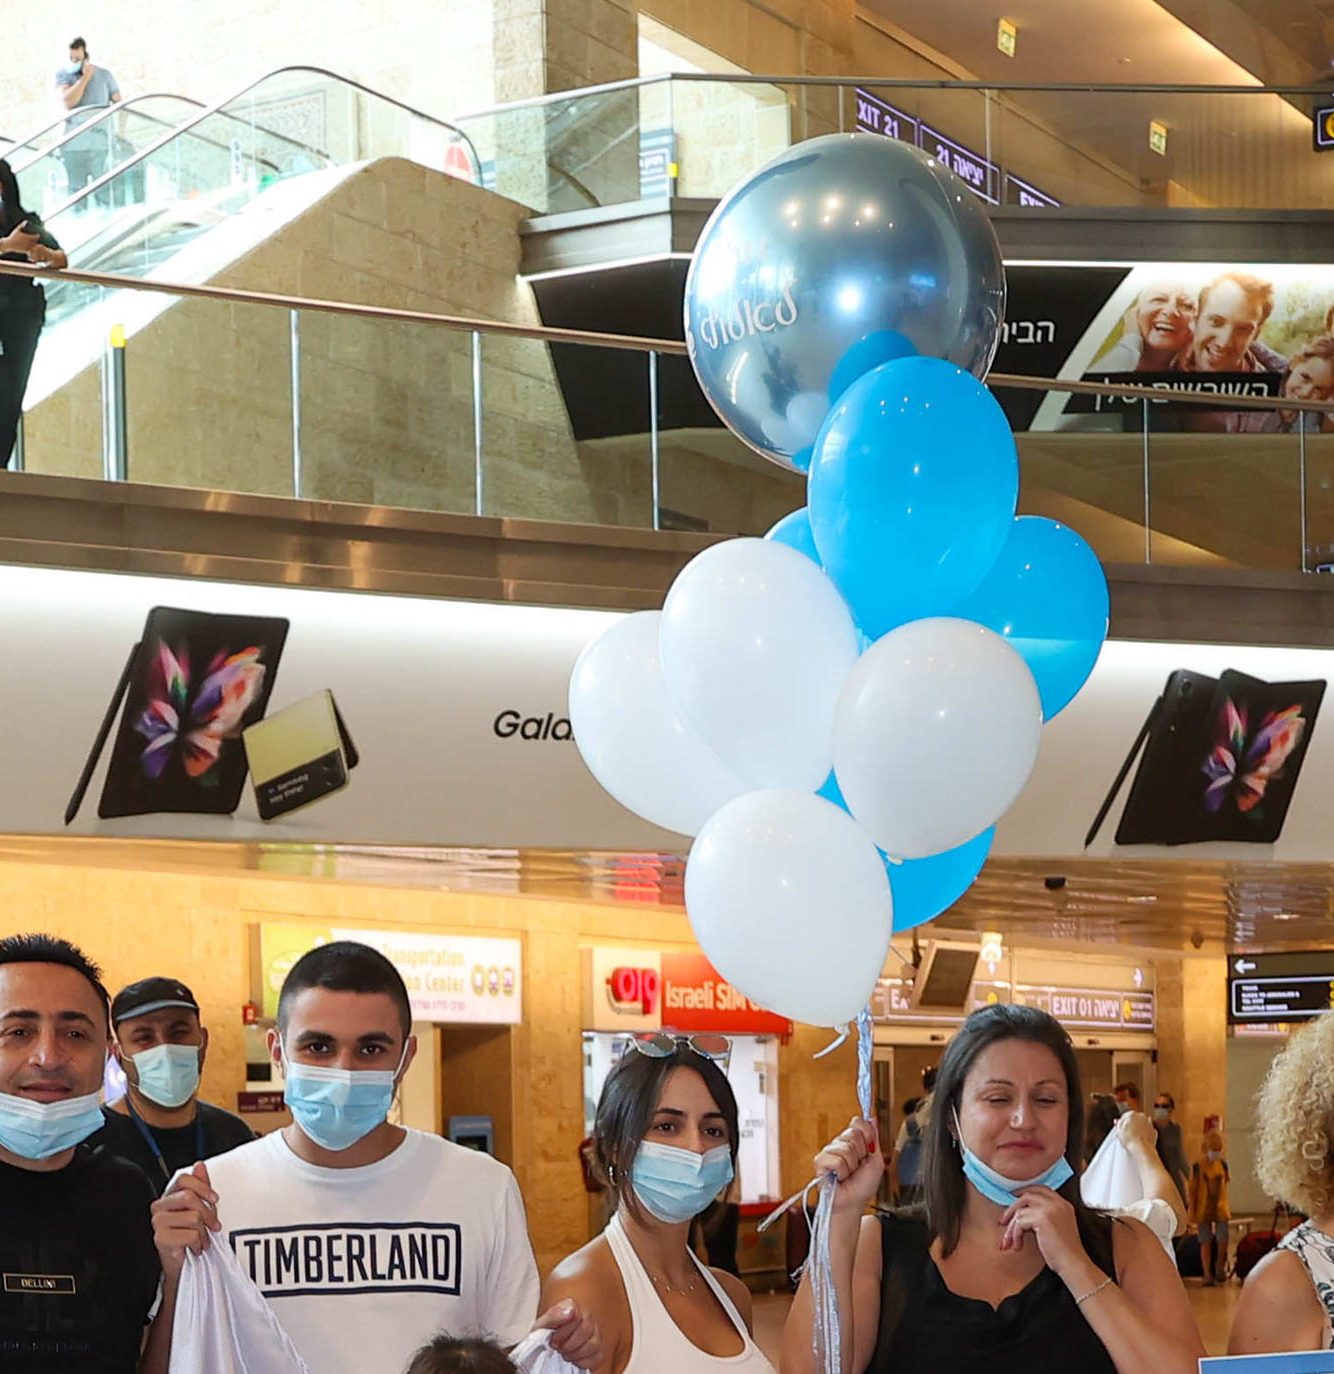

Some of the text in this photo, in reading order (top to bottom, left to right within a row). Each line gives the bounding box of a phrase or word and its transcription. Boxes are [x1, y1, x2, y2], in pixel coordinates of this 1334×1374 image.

[856, 98, 899, 139] XIT 21
[936, 145, 951, 167] 21
[493, 709, 575, 741] Gala
[424, 972, 465, 993] Center
[666, 981, 715, 1010] Israeli
[1053, 996, 1077, 1016] EXIT
[244, 1233, 451, 1286] TIMBERLAND
